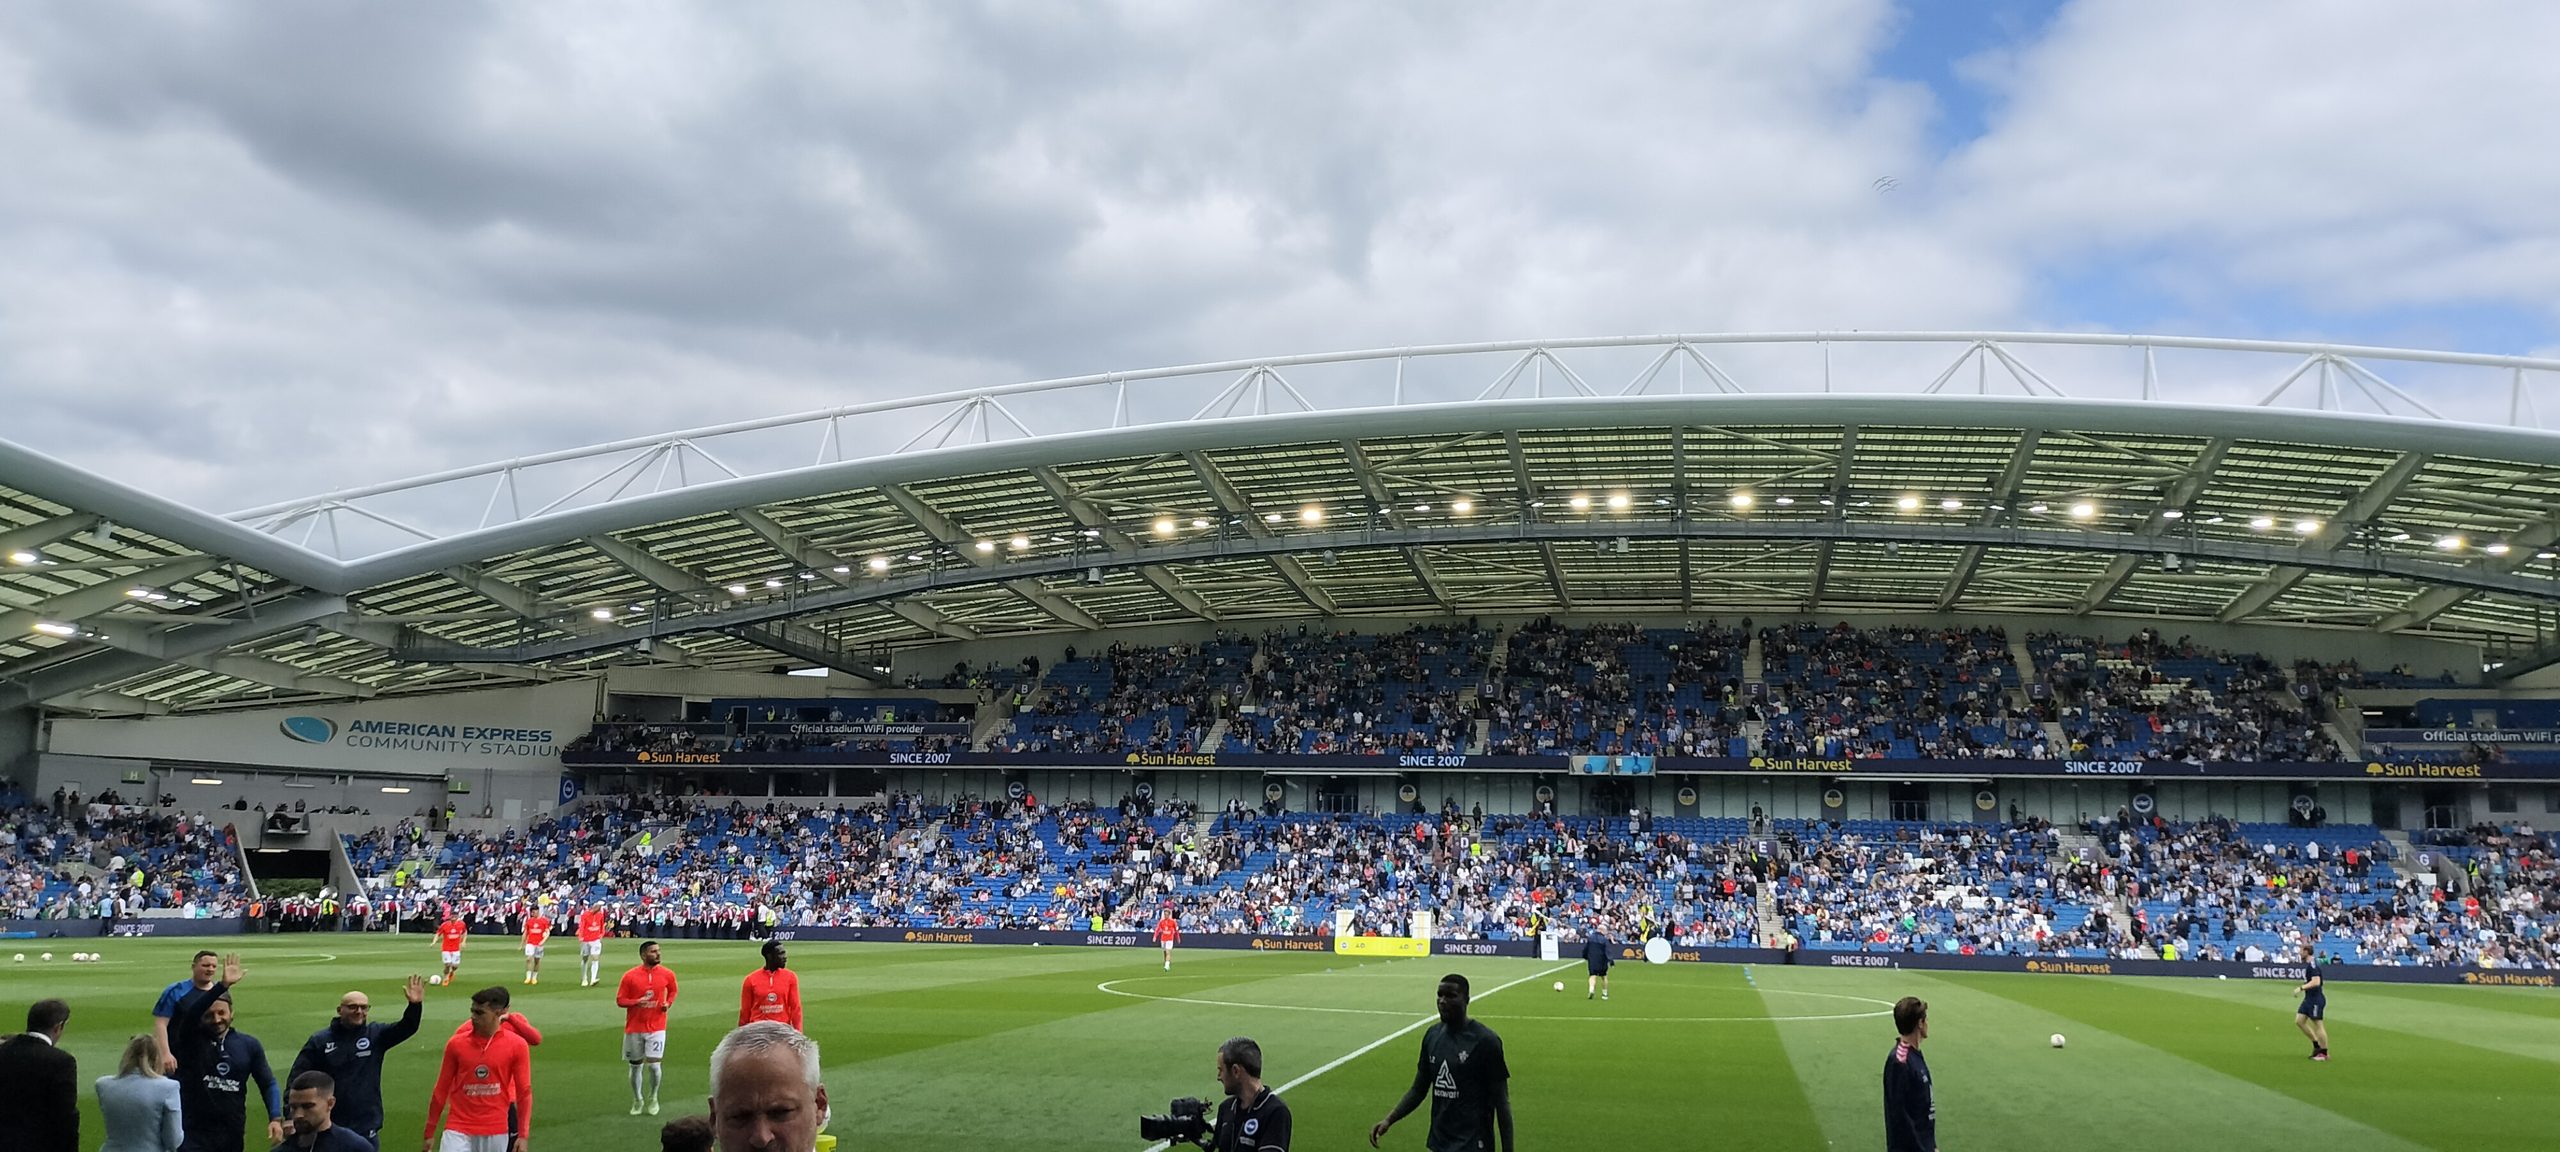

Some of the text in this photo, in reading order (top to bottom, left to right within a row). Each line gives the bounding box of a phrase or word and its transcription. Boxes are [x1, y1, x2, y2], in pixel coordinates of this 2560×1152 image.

[1022, 684, 1028, 693] B
[1486, 685, 1493, 693] D
[1751, 685, 1758, 693] E
[2034, 685, 2041, 694] F
[2300, 685, 2308, 694] G
[349, 720, 552, 742] AMERICAN EXPRESS
[825, 725, 861, 733] stadium
[886, 725, 924, 735] provider
[2422, 731, 2468, 742] Official
[2470, 732, 2521, 742] stadium
[346, 735, 472, 753] COMMUNITY
[651, 752, 720, 763] Sun Harvest
[889, 753, 951, 764] SINCE 2007
[1141, 753, 1215, 765] Sun Harvest
[1399, 755, 1466, 767] SINCE 2007
[1766, 757, 1852, 771] Sun Harvest
[2065, 761, 2143, 774] SINCE 2007
[2384, 762, 2481, 777] Sun Harvest
[130, 771, 138, 780] H
[1460, 837, 1469, 848] D
[1759, 841, 1767, 853] E
[2080, 847, 2088, 860] F
[2420, 854, 2430, 866] G
[113, 924, 155, 933] SINCE 2007
[774, 932, 796, 940] 2007
[916, 931, 973, 943] Sun Harvest
[1087, 935, 1136, 946] SINCE 2007
[1263, 938, 1323, 950] Sun Harvest
[1444, 943, 1497, 954] SINCE 2007
[1831, 955, 1889, 966] SINCE 2007
[2040, 961, 2111, 974] Sun Harvest
[2252, 967, 2286, 978] SINCE
[2478, 973, 2554, 985] Sun Harvest
[653, 1041, 663, 1051] 21
